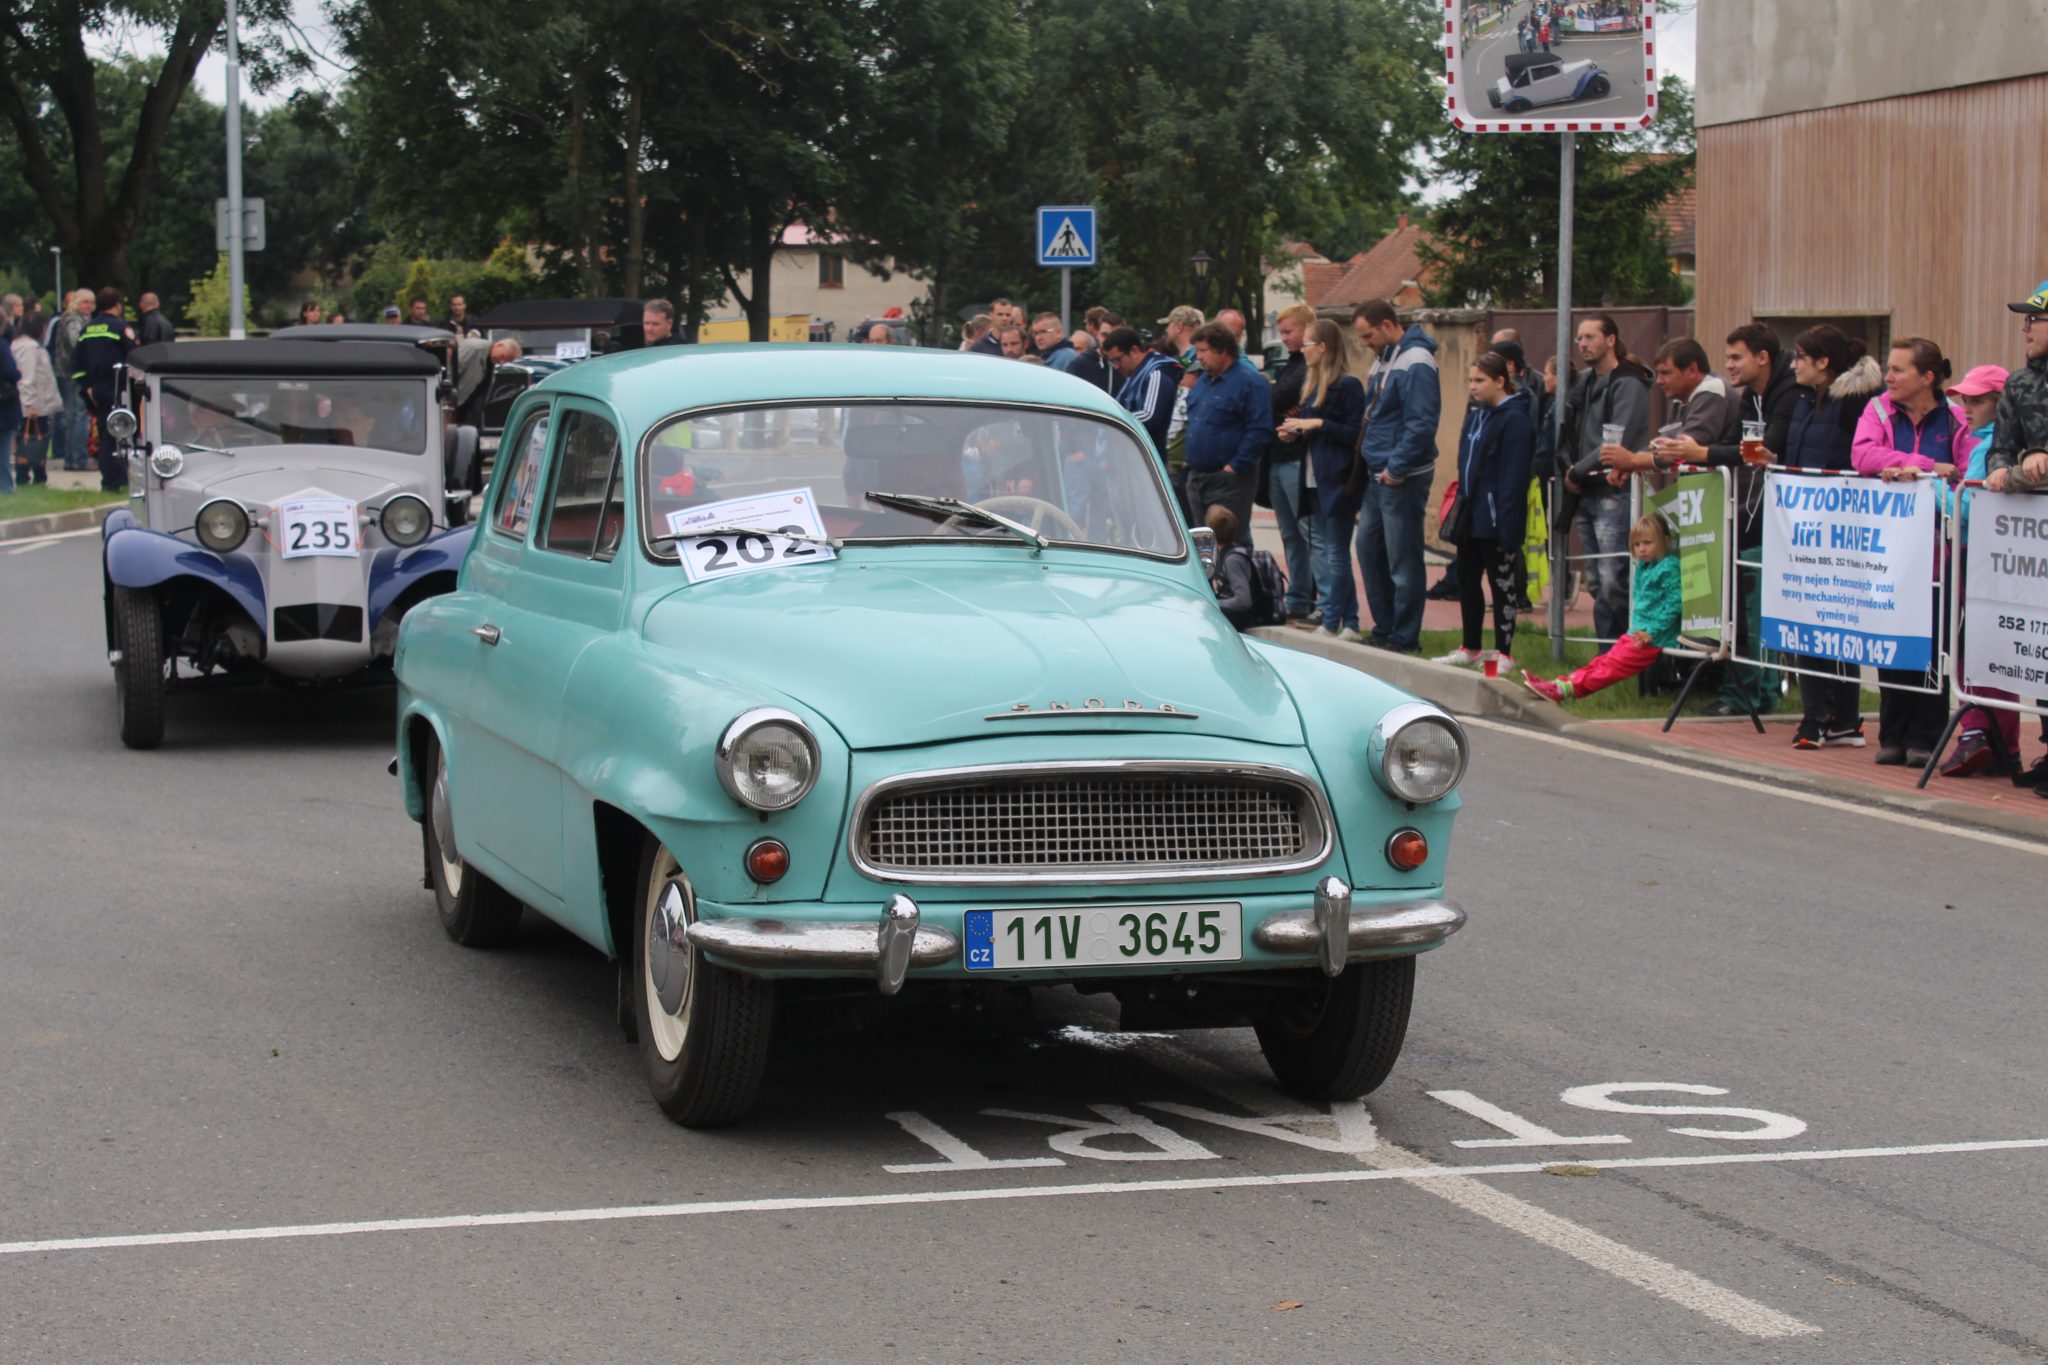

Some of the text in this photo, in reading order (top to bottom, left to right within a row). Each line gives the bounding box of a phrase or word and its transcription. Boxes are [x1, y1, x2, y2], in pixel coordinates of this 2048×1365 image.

[560, 346, 584, 357] 236
[1775, 484, 1917, 518] AUTOOPRAVNA
[289, 520, 351, 551] 235
[695, 524, 817, 572] 202
[1791, 521, 1886, 554] Jiří HAVEL
[1805, 573, 1829, 587] nejen
[1866, 563, 1888, 574] Prahy
[1998, 615, 2025, 631] 252
[2030, 620, 2041, 634] 17
[1778, 624, 1898, 665] Tel.: 311 670 147
[1988, 662, 2023, 679] e-mail:
[970, 911, 1221, 962] CZ 11V 3645
[883, 1081, 1808, 1174] START
